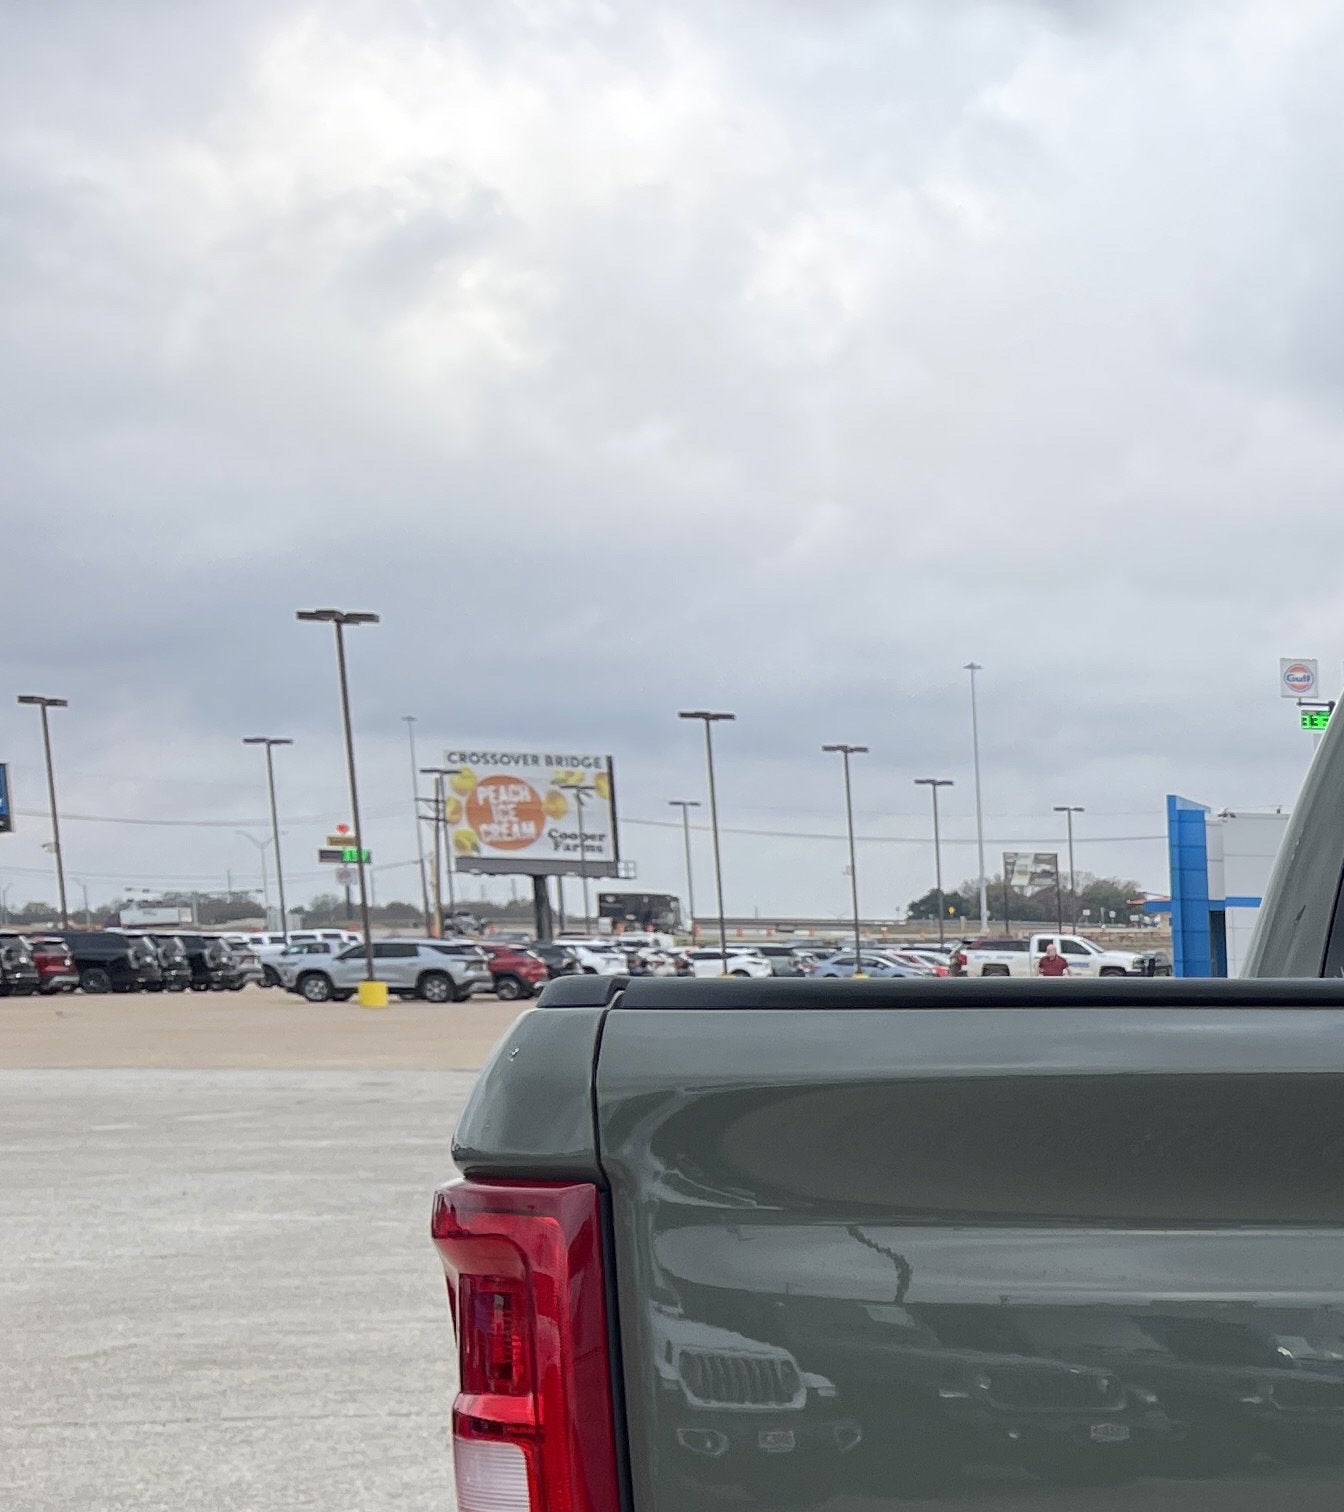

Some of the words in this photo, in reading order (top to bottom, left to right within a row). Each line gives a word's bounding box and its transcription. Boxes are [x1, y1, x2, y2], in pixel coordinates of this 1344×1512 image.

[447, 752, 540, 767] CROSSOVER
[544, 754, 601, 769] BRIDGE
[476, 784, 532, 805] PEACH
[491, 802, 518, 821] ICE
[479, 820, 537, 842] CREAM
